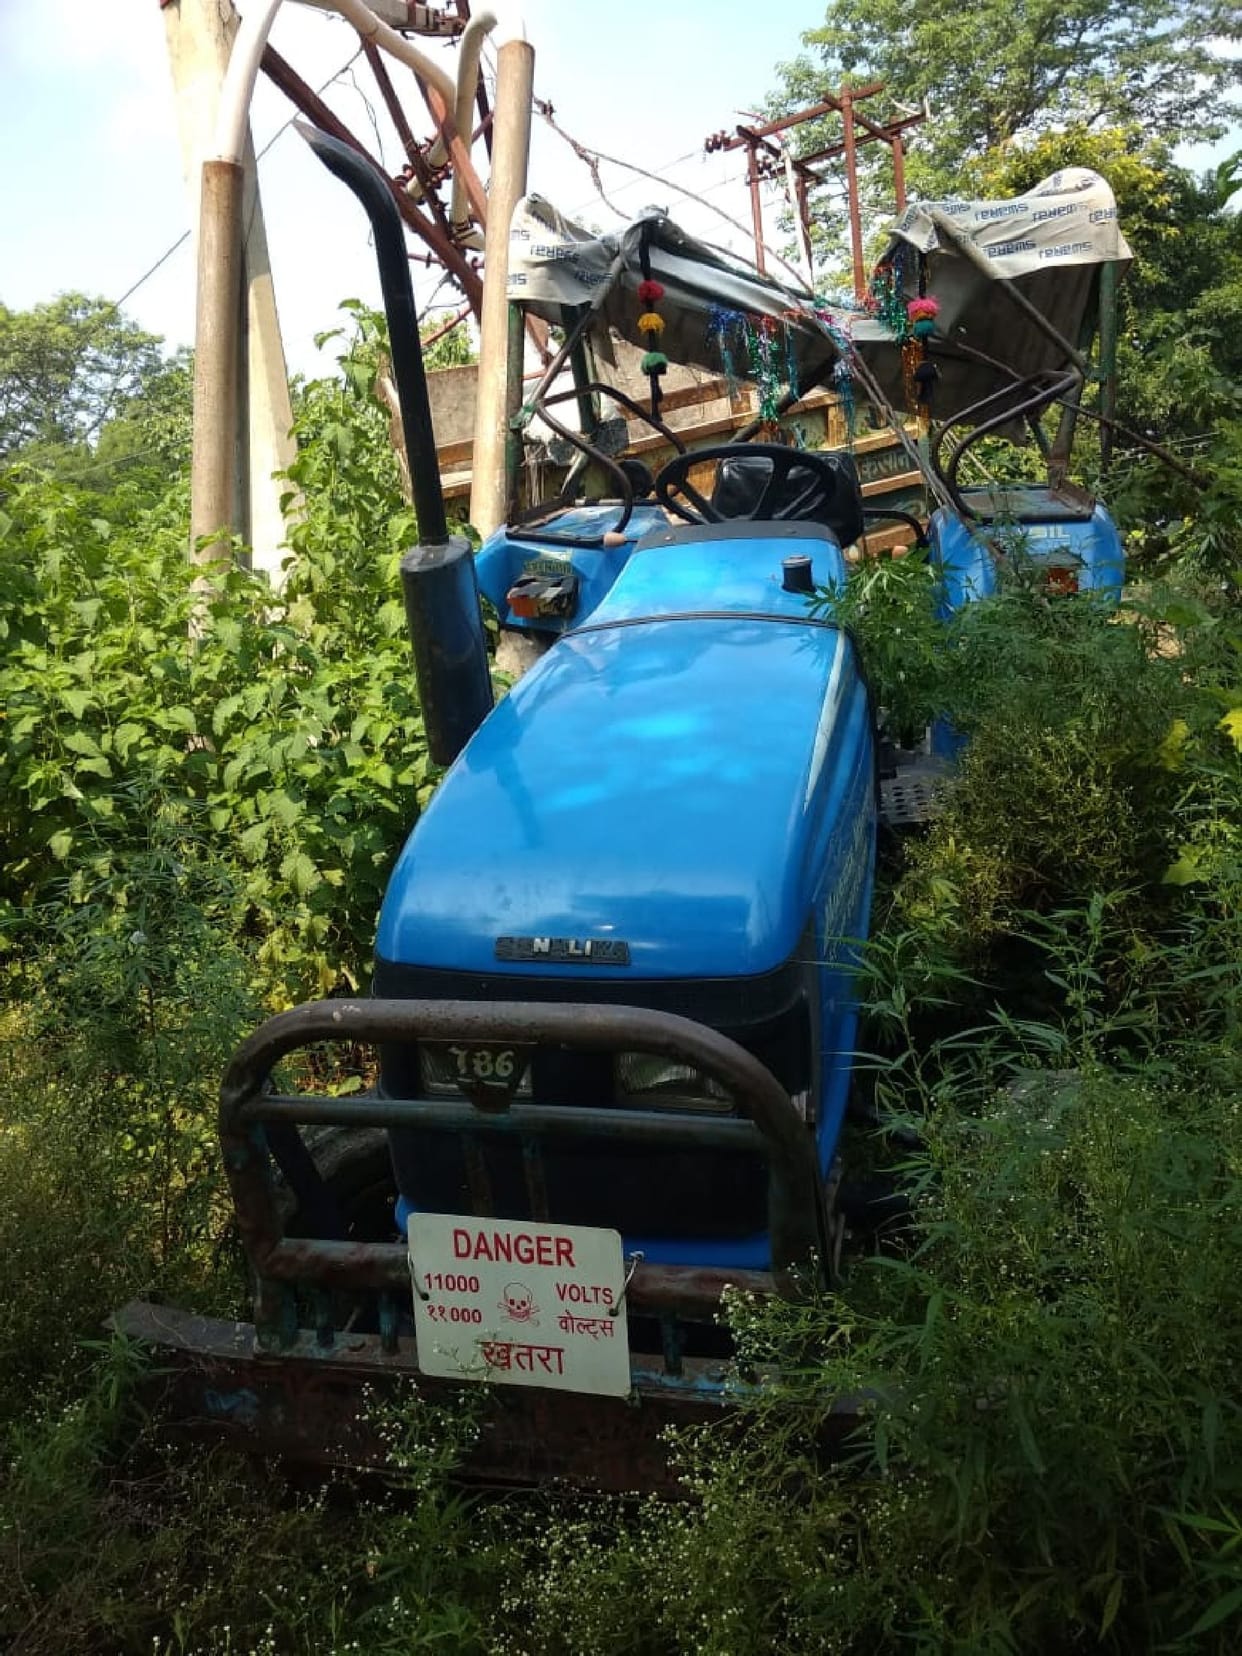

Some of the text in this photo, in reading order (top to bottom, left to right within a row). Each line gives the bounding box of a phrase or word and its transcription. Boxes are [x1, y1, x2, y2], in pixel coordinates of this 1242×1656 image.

[448, 1047, 514, 1077] 786
[453, 1228, 576, 1267] DANGER
[424, 1273, 613, 1304] 11000 VOLTS
[480, 1340, 565, 1374] खतरा
